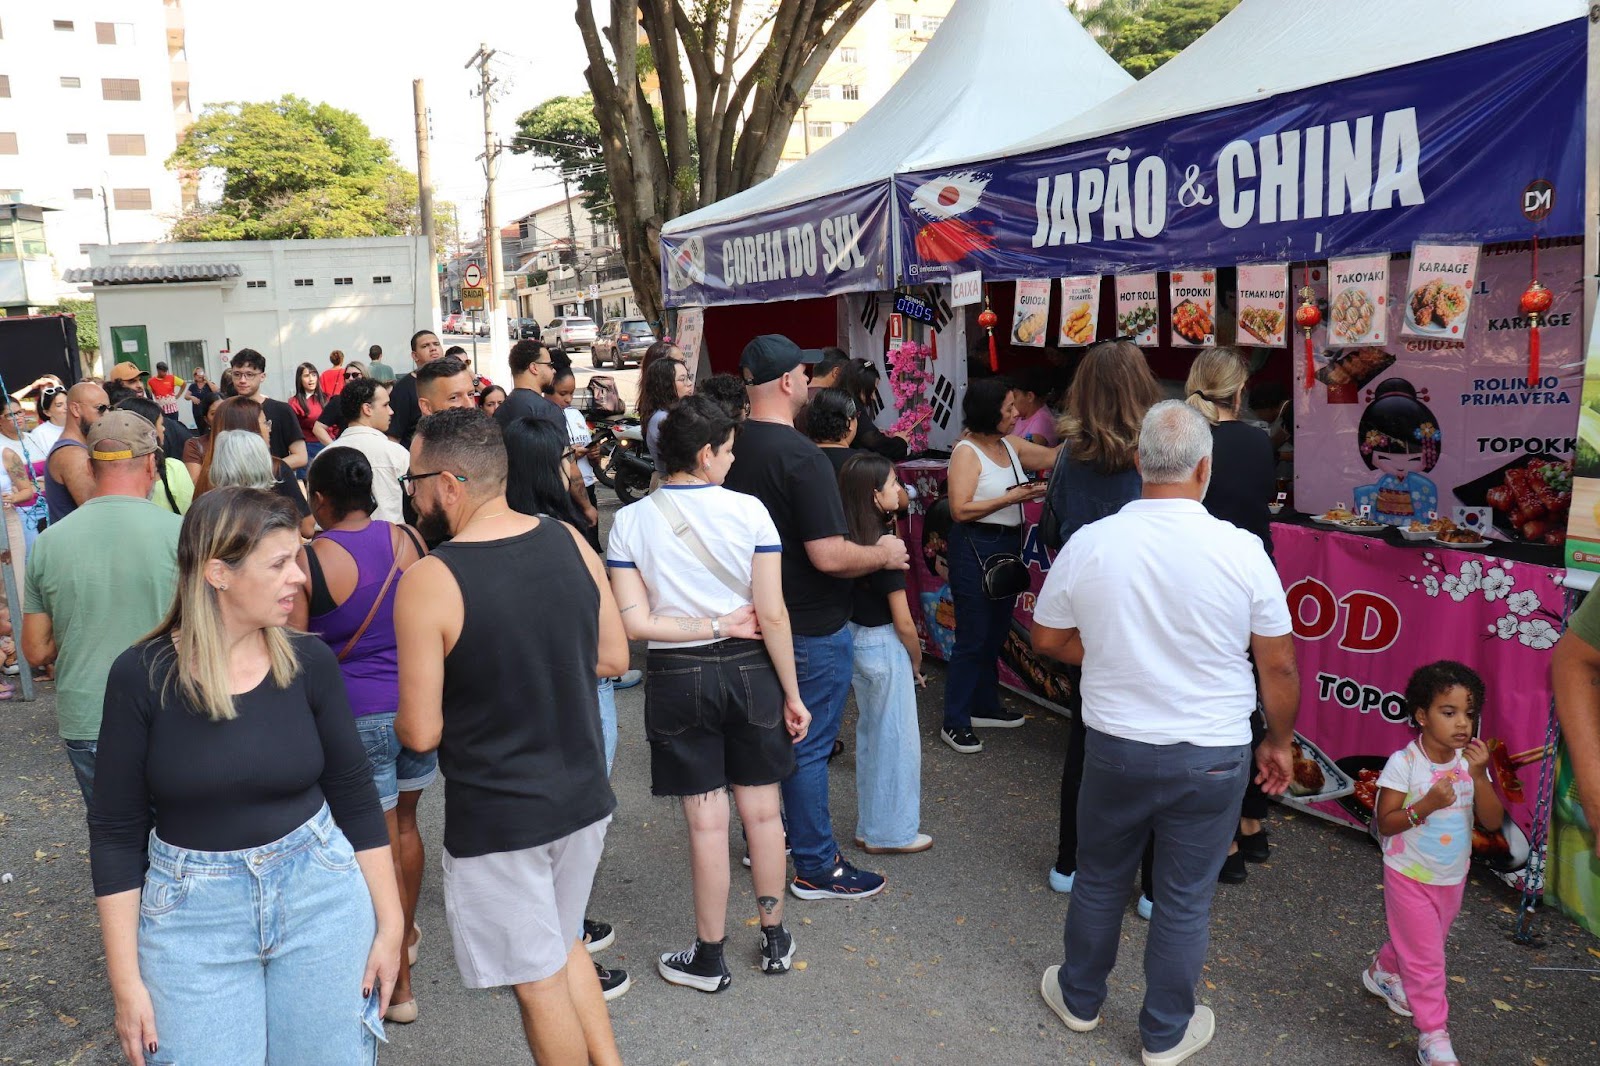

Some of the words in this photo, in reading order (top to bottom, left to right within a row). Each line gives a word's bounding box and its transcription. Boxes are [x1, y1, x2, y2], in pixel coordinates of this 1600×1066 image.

[1031, 146, 1167, 250] JAPÃO
[1178, 163, 1213, 208] &
[1216, 107, 1425, 230] CHINA
[1525, 188, 1551, 212] DM
[722, 229, 786, 287] COREIA
[787, 222, 818, 278] DO
[820, 213, 865, 274] SUL
[1418, 261, 1469, 274] KARAAGE
[1336, 270, 1384, 285] TAKOYAKI
[953, 280, 979, 299] CAIXA
[1120, 291, 1136, 301] HOT
[1137, 290, 1156, 301] ROLL
[1175, 287, 1211, 298] TOPOKKI
[1240, 289, 1268, 299] TEMAKI
[1269, 289, 1285, 299] HOT
[904, 294, 925, 307] SENHA
[1020, 295, 1046, 306] GUIOZA
[896, 298, 933, 321] 0005
[1488, 312, 1572, 332] KARAAGE
[1461, 391, 1571, 406] PRIMAVERA
[1286, 576, 1401, 653] OD
[1316, 671, 1413, 726] TOPO
